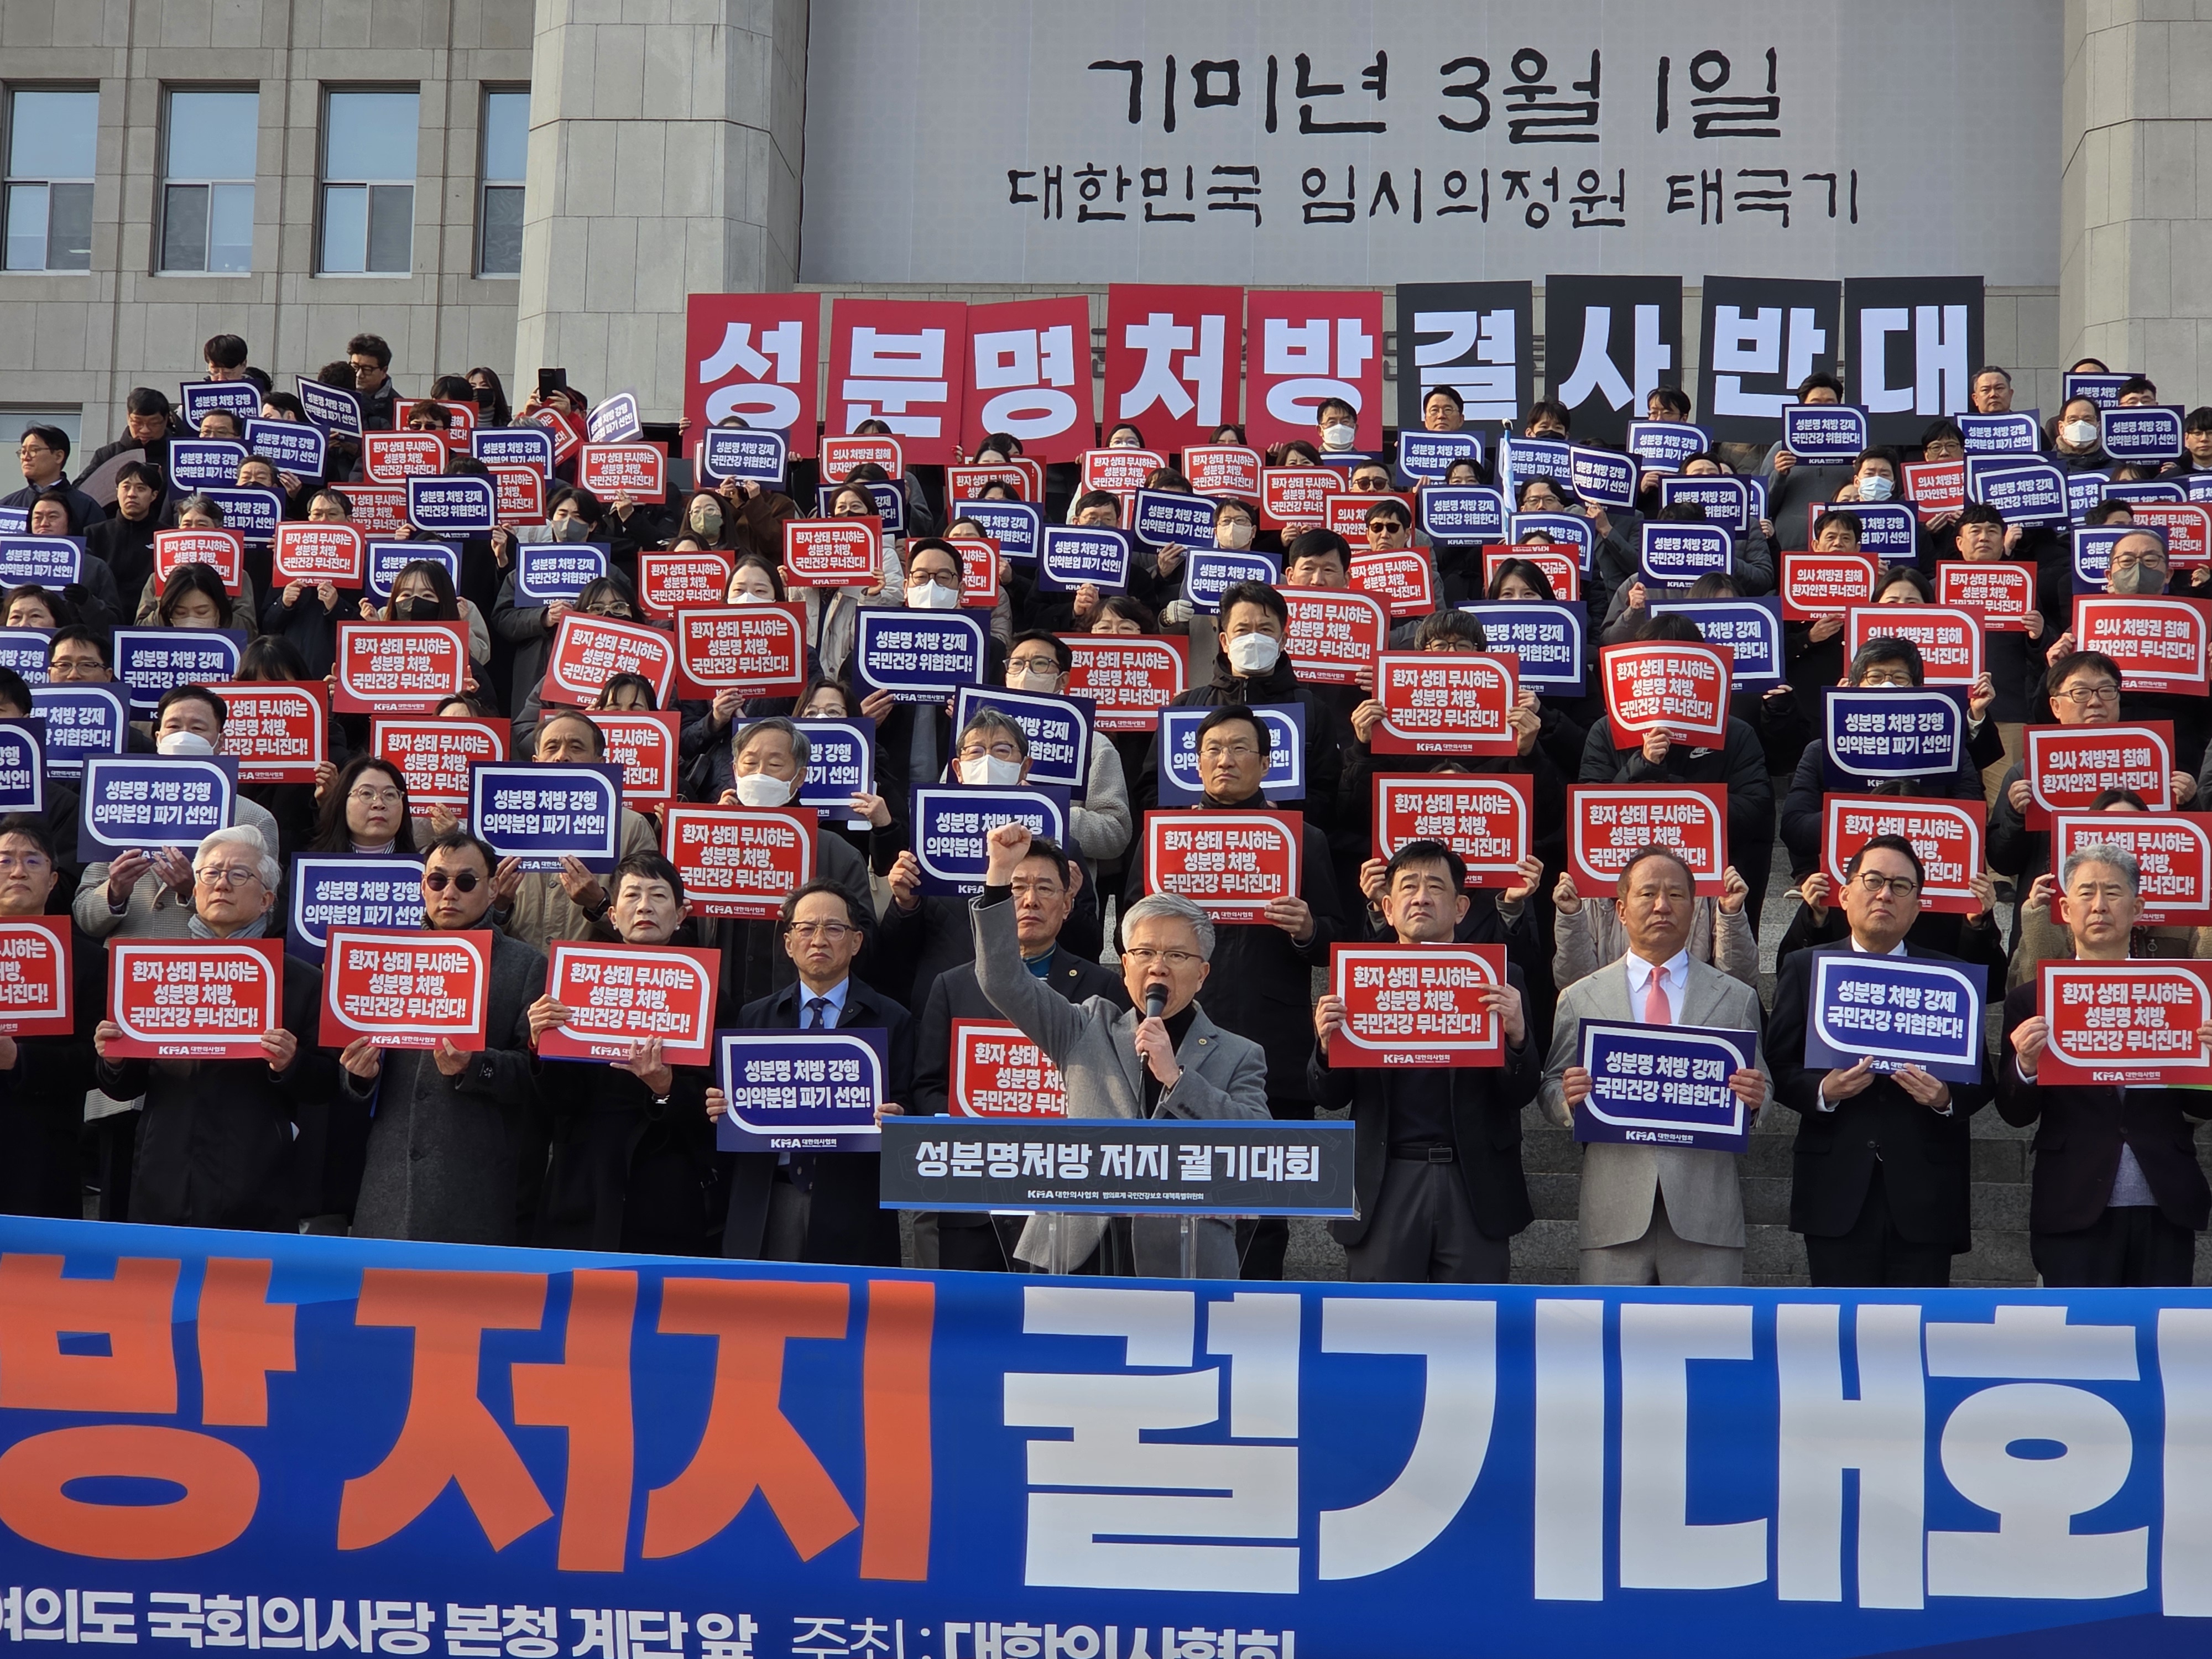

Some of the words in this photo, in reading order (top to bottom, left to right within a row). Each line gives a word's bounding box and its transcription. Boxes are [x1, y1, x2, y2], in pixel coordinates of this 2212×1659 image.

[1088, 50, 1387, 134] 기미년
[1438, 48, 1600, 144] 3월
[1008, 163, 1261, 227] 대한민국
[1302, 165, 1625, 229] 임시의정원
[1666, 169, 1858, 228] 태극기
[1796, 419, 1820, 431] 성분명
[1822, 419, 1839, 430] 처방
[1839, 419, 1856, 431] 강제
[2112, 421, 2137, 434] 성분명
[2137, 421, 2154, 432] 처방
[2155, 420, 2172, 432] 강행
[256, 432, 280, 446] 성분명
[280, 435, 298, 448] 처방
[298, 437, 315, 450] 강행
[1791, 432, 1825, 444] 국민건강
[1825, 432, 1860, 444] 위협한다!
[2107, 434, 2140, 446] 의약분업
[2140, 434, 2157, 446] 파기
[2158, 434, 2177, 445] 선언!
[282, 448, 296, 460] 파기
[300, 451, 318, 464] 선언!
[420, 491, 445, 503] 성분명
[446, 490, 464, 503] 처방
[465, 490, 483, 503] 강제
[415, 505, 450, 518] 국민건강
[450, 504, 487, 517] 위협한다!
[285, 533, 301, 545] 환자
[301, 533, 319, 544] 상태
[319, 533, 352, 546] 무시하는
[1055, 541, 1080, 554] 성분명
[1080, 541, 1099, 556] 처방
[1100, 544, 1118, 558] 강행
[295, 545, 319, 556] 성분명
[319, 545, 338, 558] 처방,
[283, 556, 315, 568] 국민건강
[315, 557, 351, 570] 무너진다!
[1048, 555, 1081, 569] 의약분업
[1081, 557, 1100, 570] 파기
[1101, 559, 1121, 573] 선언!
[875, 631, 912, 649] 성분명
[914, 632, 940, 650] 처방
[942, 633, 967, 651] 강제
[868, 651, 918, 671] 국민건강
[919, 653, 973, 672] 위협한다!
[1392, 669, 1419, 687] 환자
[1420, 670, 1446, 687] 상태
[1448, 670, 1499, 688] 무시하는
[1410, 689, 1448, 707] 성분명
[1451, 689, 1480, 710] 처방,
[1391, 708, 1442, 727] 국민건강
[1444, 709, 1499, 728] 무너진다!
[1845, 713, 1886, 733] 성분명
[1887, 713, 1916, 733] 처방
[1918, 712, 1944, 732] 강행
[1837, 735, 1890, 755] 의약분업
[1892, 736, 1919, 755] 파기
[1921, 734, 1952, 754] 선언!
[2049, 750, 2077, 770] 의사
[2079, 749, 2120, 769] 처방권
[2122, 748, 2151, 768] 침해
[105, 781, 148, 801] 성분명
[150, 781, 181, 801] 처방
[182, 782, 211, 802] 강행
[2042, 773, 2097, 793] 환자안전
[2099, 771, 2158, 791] 무너진다!
[94, 804, 152, 824] 의약분업
[153, 805, 183, 825] 파기
[185, 805, 218, 825] 선언!
[132, 961, 164, 982] 환자
[166, 961, 196, 982] 상태
[199, 961, 259, 982] 무시하는
[348, 949, 380, 971] 환자
[382, 951, 412, 973] 상태
[414, 952, 469, 973] 무시하는
[368, 973, 414, 995] 성분명
[415, 975, 447, 999] 처방,
[570, 962, 601, 984] 환자
[603, 965, 634, 986] 상태
[635, 967, 694, 990] 무시하는
[1353, 966, 1385, 988] 환자
[1387, 967, 1418, 988] 상태
[1421, 967, 1481, 988] 무시하는
[153, 984, 199, 1005] 성분명
[201, 984, 236, 1008] 처방,
[589, 985, 634, 1008] 성분명
[635, 988, 670, 1013] 처방,
[1375, 990, 1421, 1011] 성분명
[1423, 990, 1459, 1014] 처방,
[1838, 980, 1886, 1005] 성분명
[1887, 985, 1922, 1009] 처방
[1924, 989, 1957, 1013] 강제
[2062, 983, 2095, 1004] 환자
[2096, 983, 2128, 1005] 상태
[2131, 983, 2193, 1004] 무시하는
[130, 1006, 191, 1027] 국민건강
[194, 1007, 258, 1028] 무너진다!
[345, 994, 405, 1018] 국민건강
[406, 998, 466, 1019] 무너진다!
[566, 1006, 625, 1029] 국민건강
[626, 1010, 691, 1034] 무너진다!
[1353, 1013, 1414, 1035] 국민건강
[1416, 1013, 1481, 1034] 무너진다!
[1827, 1006, 1892, 1031] 국민건강
[1893, 1012, 1964, 1039] 위협한다!
[2084, 1006, 2131, 1028] 성분명
[2133, 1006, 2169, 1030] 처방,
[2061, 1030, 2124, 1051] 국민건강
[2126, 1030, 2193, 1051] 무너진다!
[744, 1060, 791, 1082] 성분명
[794, 1060, 826, 1082] 처방
[828, 1059, 860, 1082] 강행
[1605, 1051, 1654, 1076] 성분명
[1656, 1055, 1690, 1078] 처방
[1692, 1058, 1725, 1082] 강제
[735, 1087, 797, 1109] 의약분업
[800, 1086, 831, 1108] 파기
[834, 1086, 871, 1108] 선언!
[1595, 1076, 1660, 1102] 국민건강
[1661, 1082, 1731, 1108] 위협한다!
[915, 1141, 1093, 1179] 성분명처방
[1100, 1144, 1169, 1180] 저지
[1177, 1145, 1319, 1182] 궐기대회
[1027, 1190, 1054, 1198] KMA
[1055, 1191, 1099, 1199] 대한의사협회
[337, 1269, 936, 1581] 저지
[1004, 1286, 2212, 1616] 궐기대회
[147, 1592, 435, 1655] 국회의사당
[444, 1603, 559, 1658] 본청
[570, 1609, 688, 1659] 계단
[697, 1610, 759, 1659] 앞
